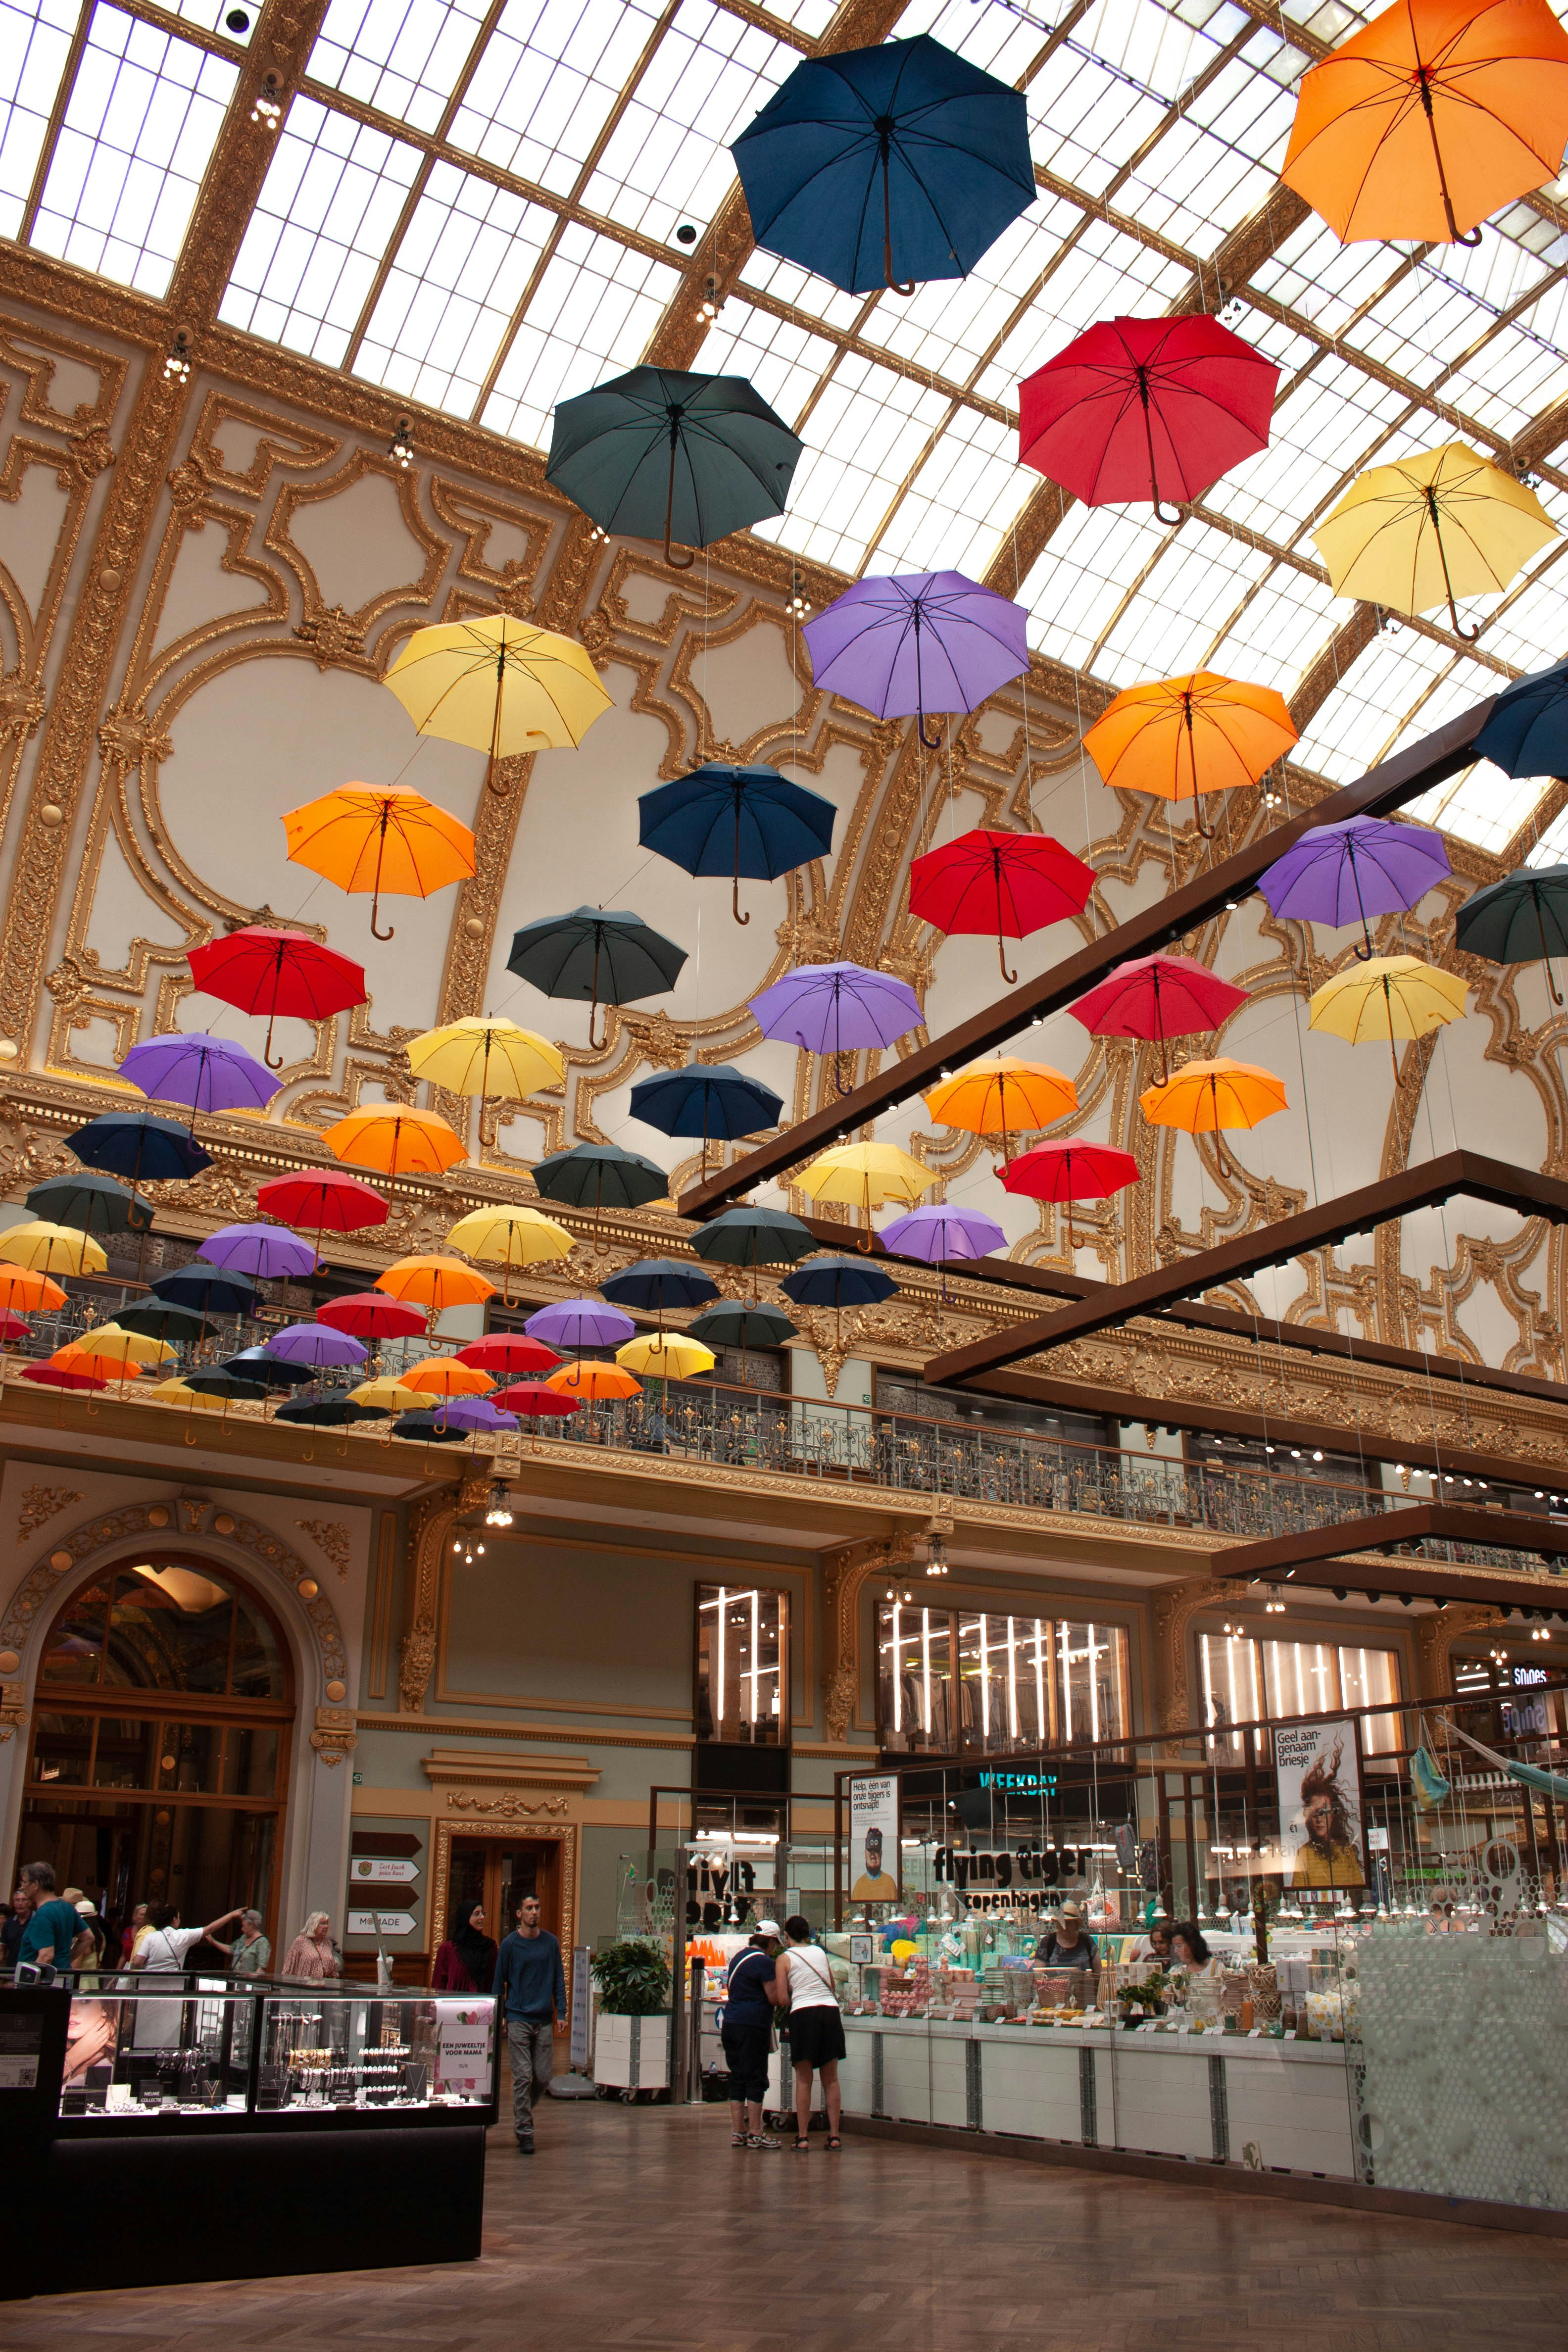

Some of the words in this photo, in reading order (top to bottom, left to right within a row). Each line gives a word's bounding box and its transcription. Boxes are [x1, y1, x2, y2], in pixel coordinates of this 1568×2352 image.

[1277, 1730, 1298, 1744] Geel
[1301, 1731, 1321, 1741] aan-
[1278, 1742, 1316, 1757] genaam
[1279, 1753, 1309, 1767] briesje
[853, 1781, 867, 1792] Help,
[869, 1780, 879, 1789] één
[979, 1772, 1057, 1796] WEEKDAY
[868, 1790, 885, 1801] tijgers
[886, 1788, 890, 1798] is
[853, 1800, 879, 1811] ontsnapt!
[1289, 1824, 1298, 1833] €1
[933, 1845, 1012, 1890] flying
[1016, 1840, 1093, 1887] tiger
[965, 1889, 1060, 1912] copenhagen
